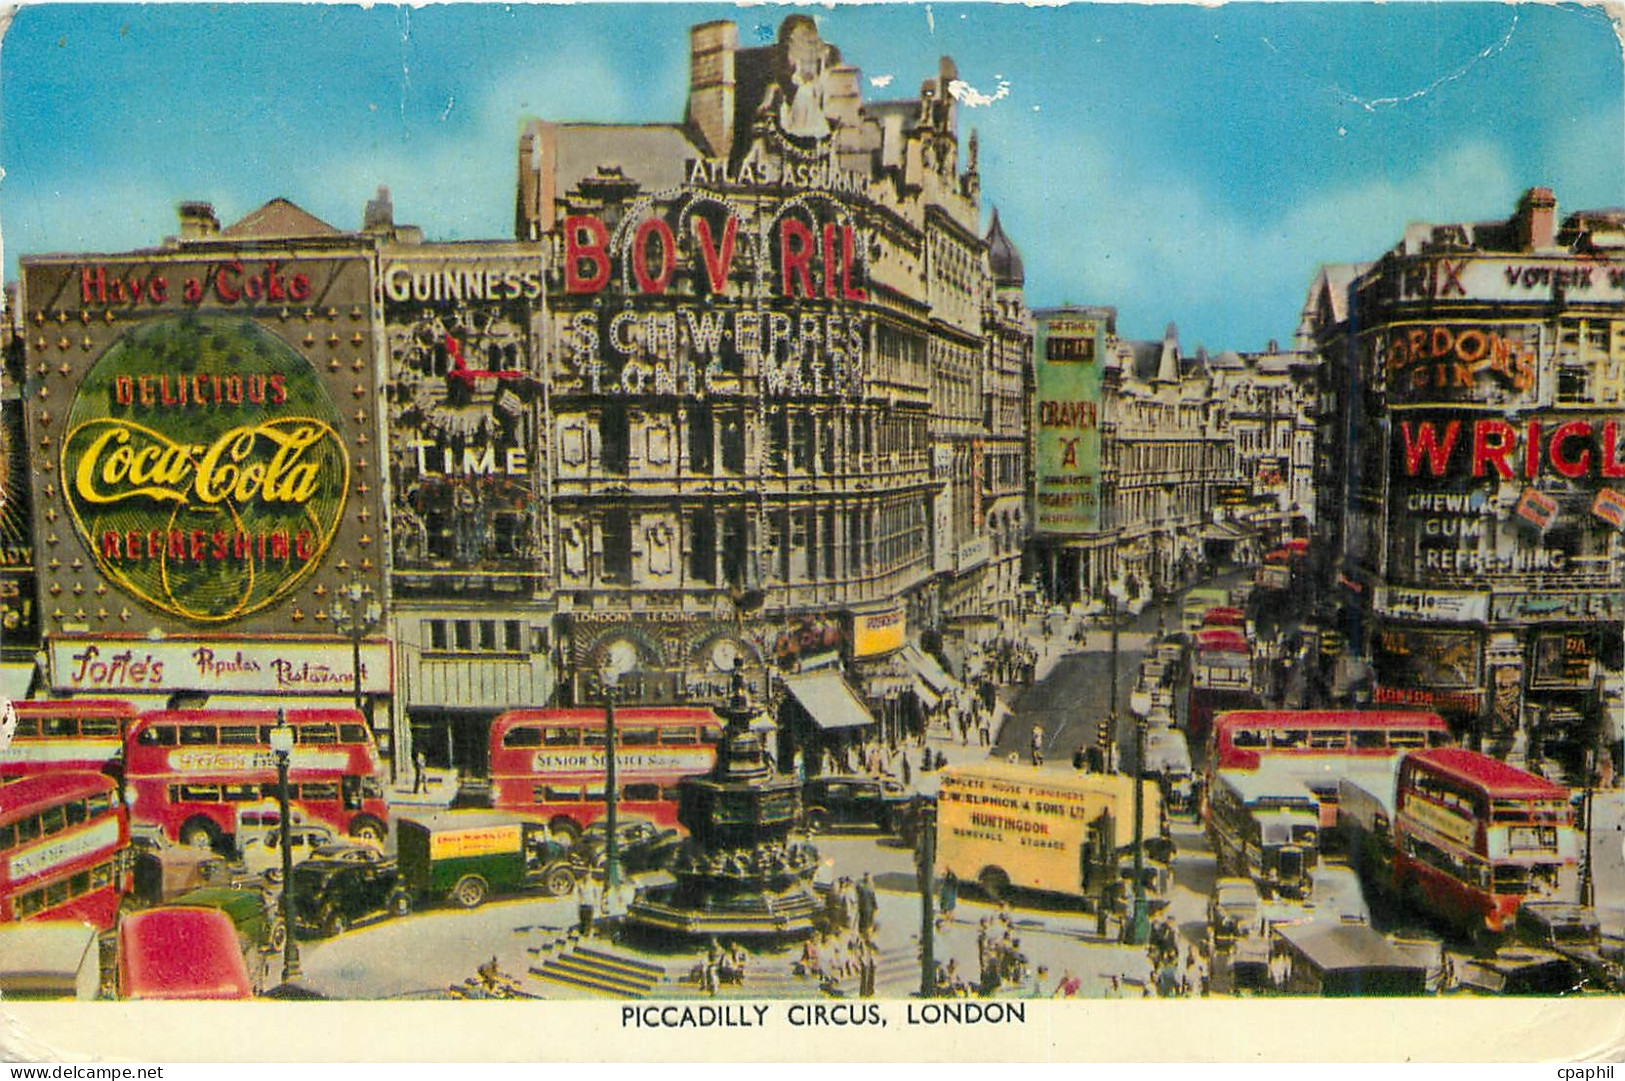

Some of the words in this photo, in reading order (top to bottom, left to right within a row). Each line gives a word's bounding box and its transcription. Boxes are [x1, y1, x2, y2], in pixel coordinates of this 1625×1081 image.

[690, 158, 768, 185] ATLAS
[563, 215, 867, 301] BOVRIL
[82, 265, 168, 304] Have
[184, 276, 201, 301] a
[215, 261, 313, 304] Coke
[572, 310, 864, 356] SCHWEPPES
[1384, 326, 1536, 392] ORDON'S
[1411, 361, 1474, 389] GIN
[116, 374, 288, 407] DELICIOUS
[581, 358, 740, 396] TONIC
[1040, 400, 1097, 429] CRAVEN
[76, 421, 328, 505] Coca-Cola
[406, 438, 529, 478] TIME
[1402, 418, 1625, 479] WRIGL
[1426, 517, 1481, 537] GUM
[102, 528, 313, 561] REFRESHING
[646, 611, 698, 624] LEADING
[72, 644, 164, 687] Forte's
[537, 752, 587, 768] SENIOR
[591, 751, 643, 768] SEVICE
[971, 811, 1051, 836] HUNTINGDON
[1035, 801, 1065, 816] SONS
